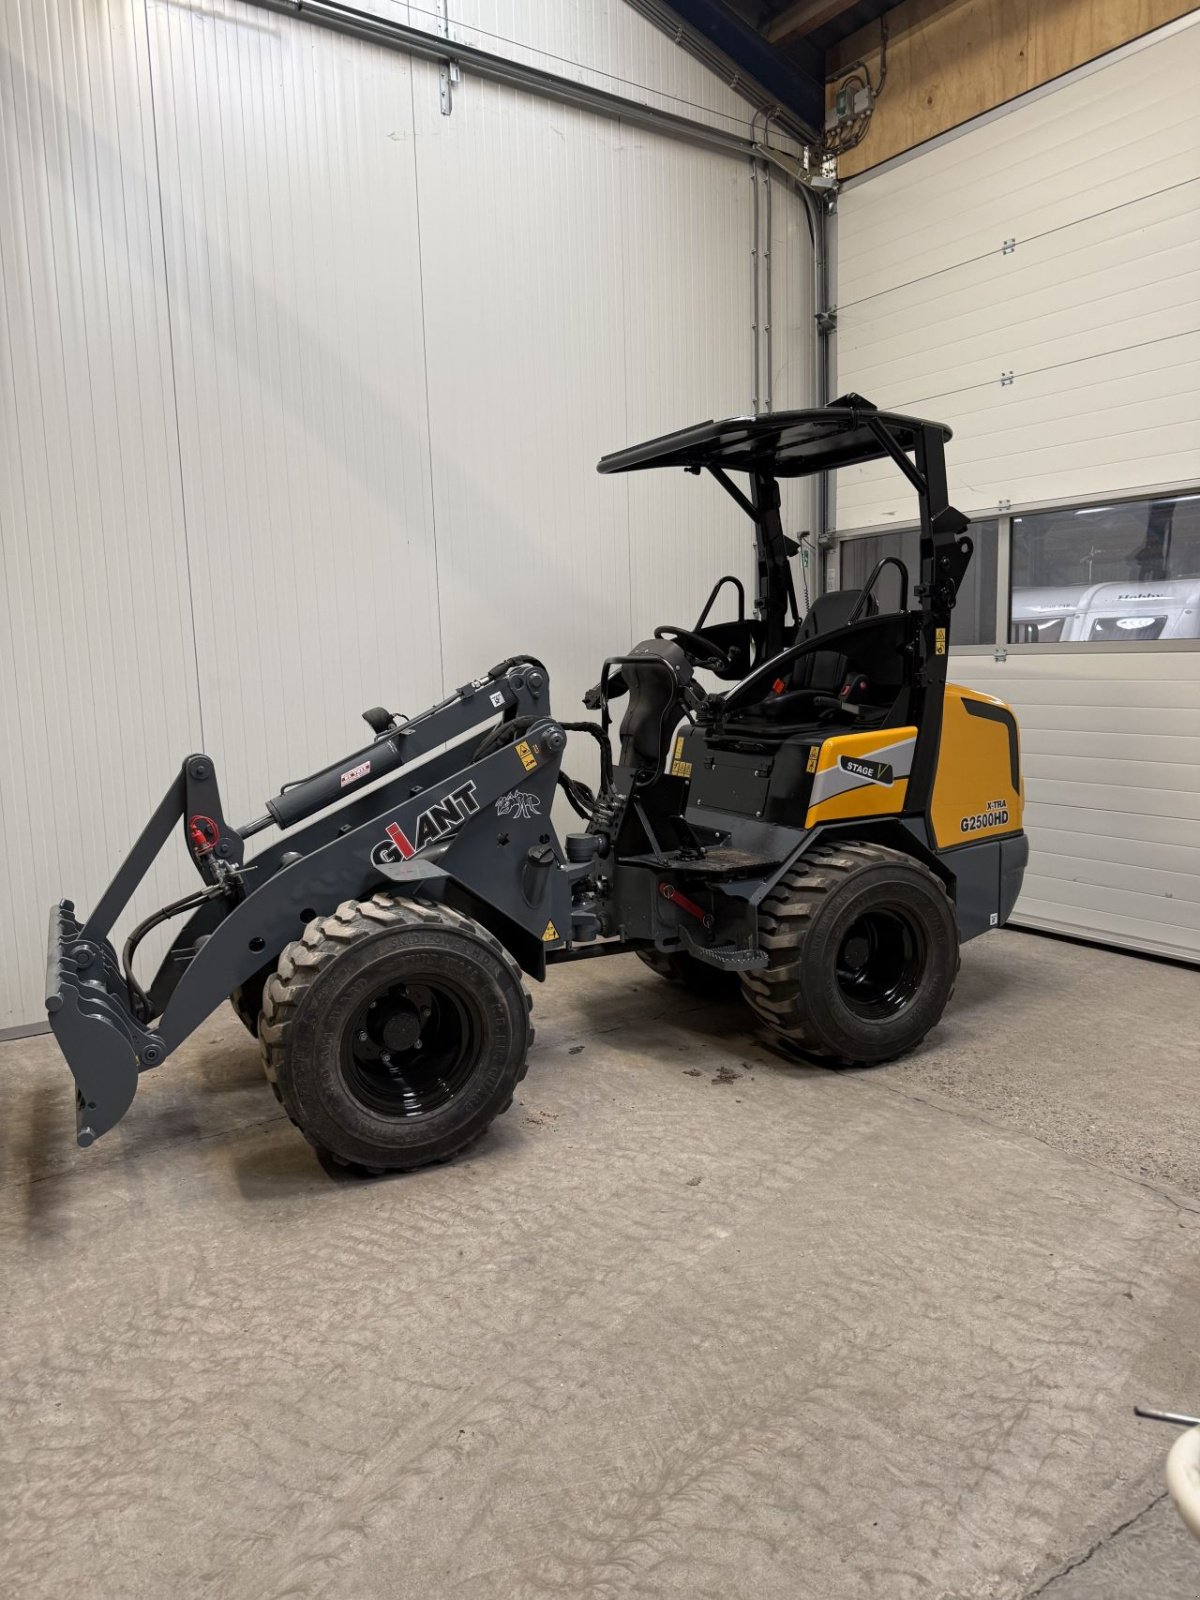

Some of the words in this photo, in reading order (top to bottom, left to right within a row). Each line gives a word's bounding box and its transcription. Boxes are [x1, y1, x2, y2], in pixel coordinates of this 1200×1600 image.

[847, 762, 873, 777] STAGE
[877, 763, 889, 779] V
[986, 799, 1007, 811] X-TRA
[370, 779, 480, 868] GIANT
[960, 810, 1008, 832] G2500HD
